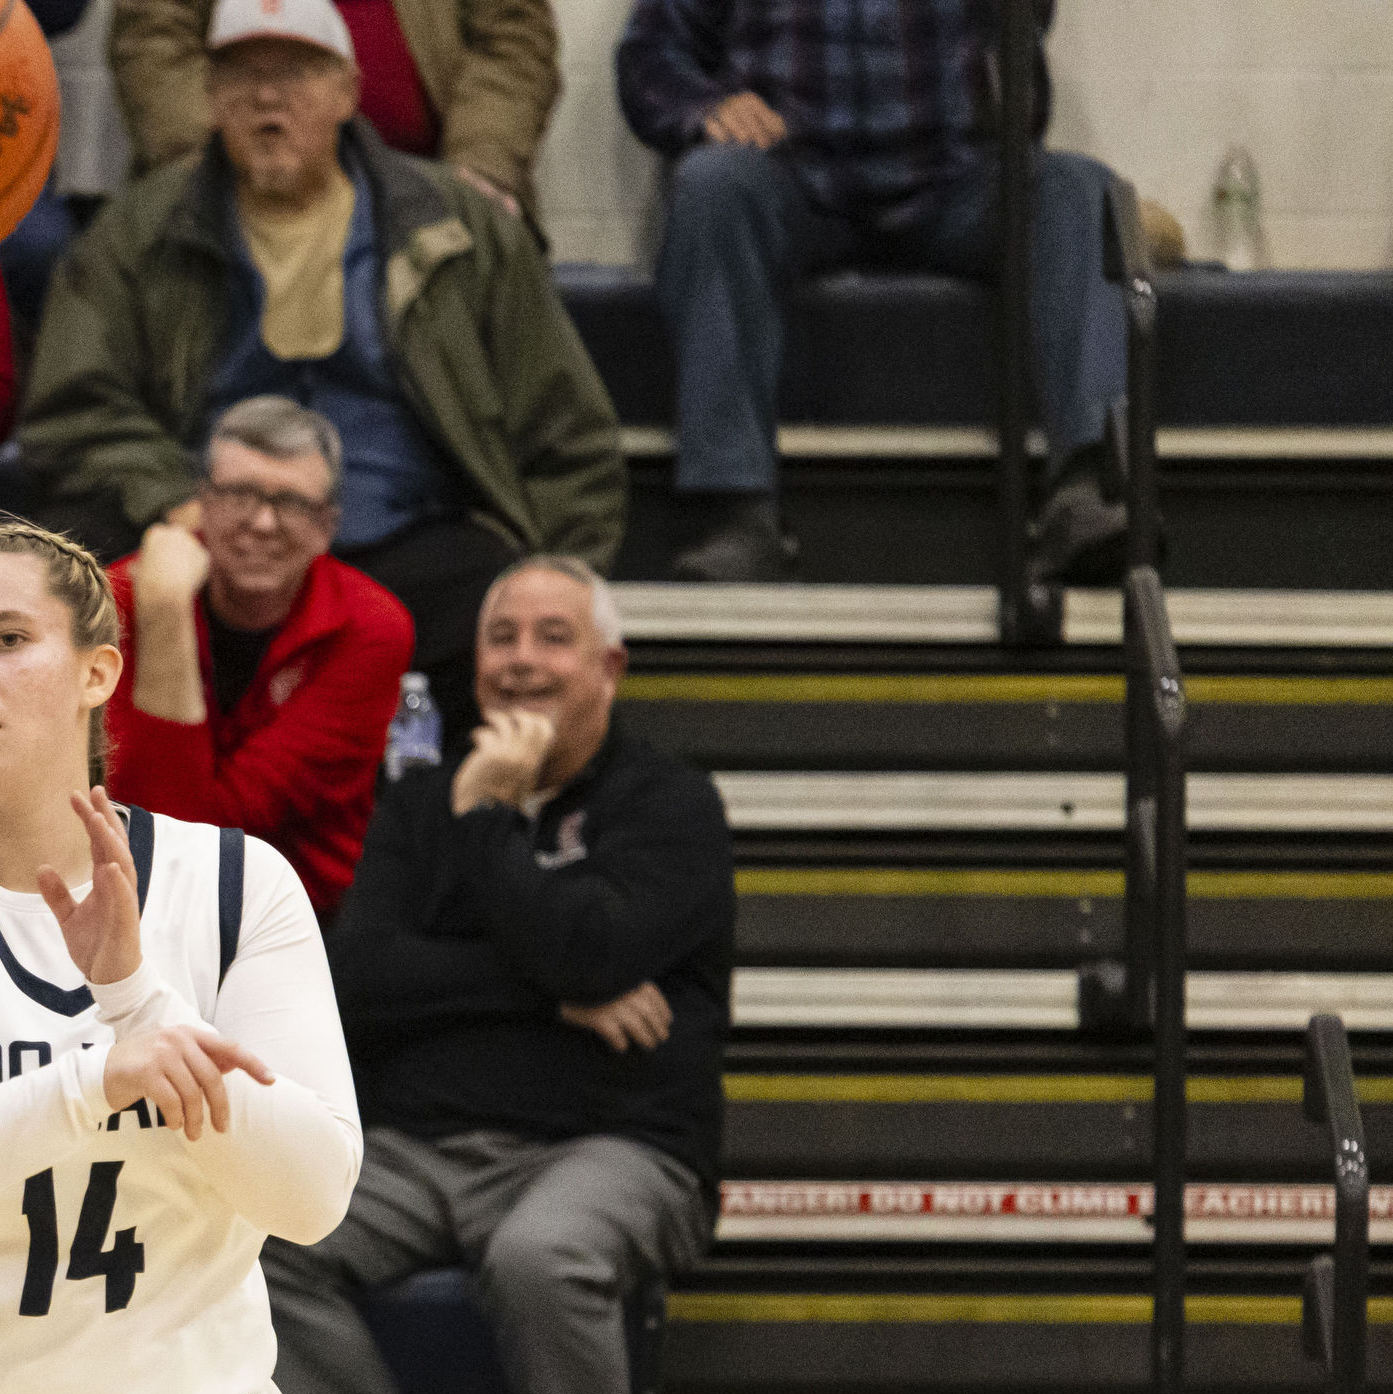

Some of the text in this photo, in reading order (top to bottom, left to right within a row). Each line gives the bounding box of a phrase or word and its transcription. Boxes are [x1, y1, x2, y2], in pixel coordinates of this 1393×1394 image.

[18, 1159, 146, 1317] 14
[722, 1185, 858, 1213] ANGER!
[870, 1186, 924, 1213] DO
[933, 1186, 1005, 1214] NOT
